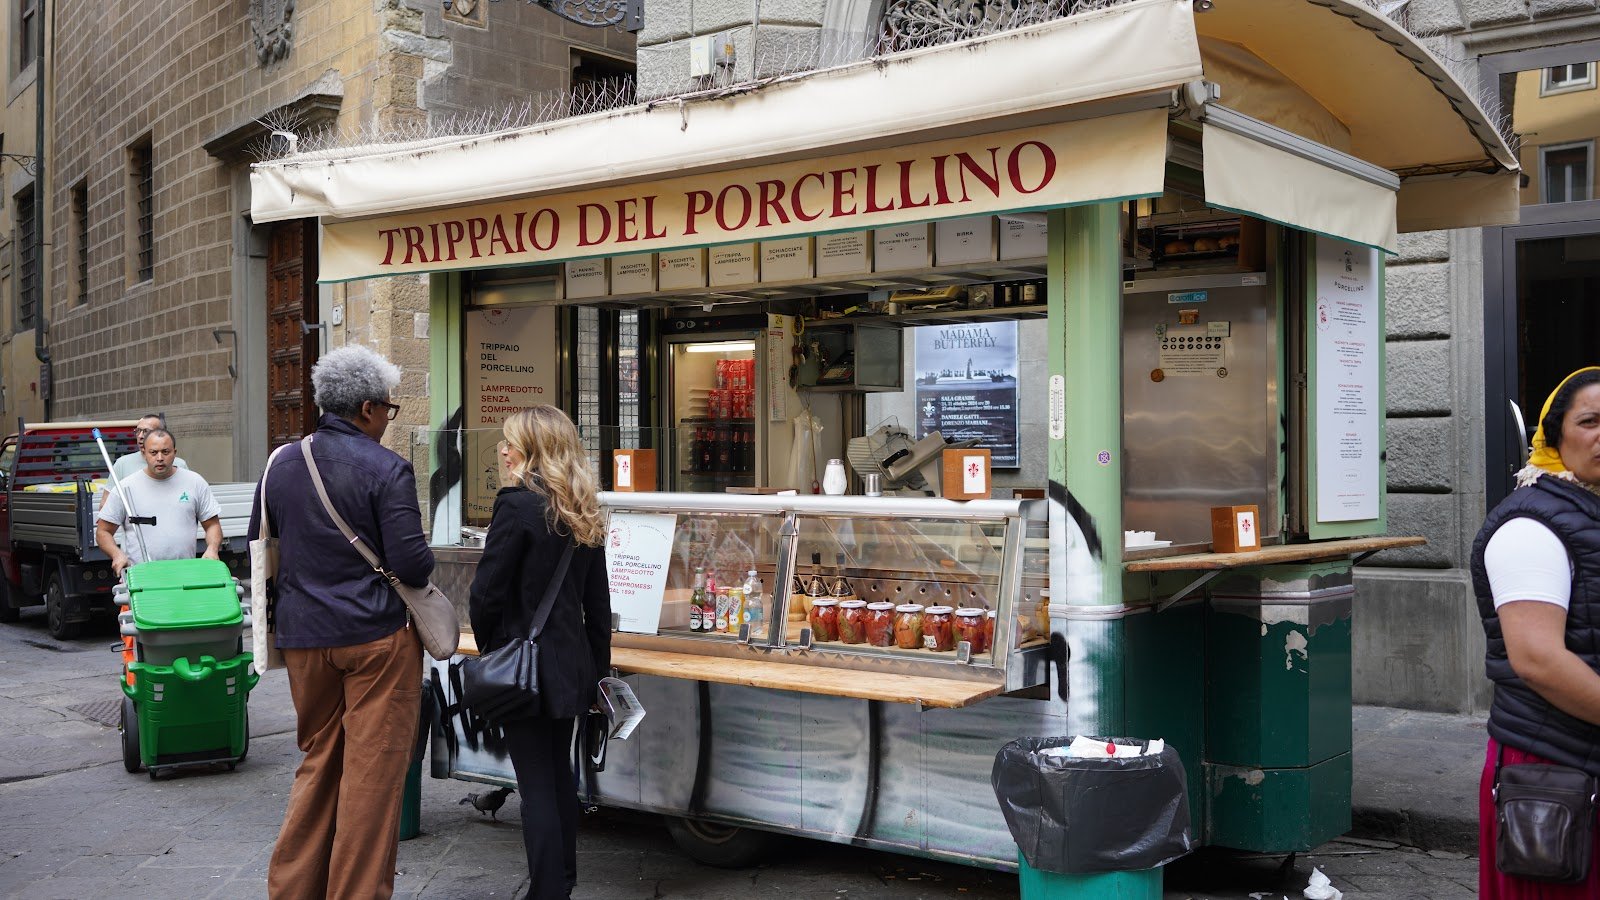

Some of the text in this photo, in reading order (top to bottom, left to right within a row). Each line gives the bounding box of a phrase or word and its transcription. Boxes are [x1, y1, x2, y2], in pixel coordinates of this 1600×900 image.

[378, 140, 1058, 267] TRIPPAIO DEL PORCELLINO
[768, 245, 803, 255] SCHIACCIATE
[668, 256, 695, 264] VASCHETTA
[714, 256, 751, 265] LAMPREDOTTO
[571, 271, 603, 279] LAMPREDOTTO
[617, 267, 650, 276] LAMPREDOTTO
[1334, 280, 1364, 293] PORCELLINO
[940, 328, 991, 340] MADAMA
[480, 342, 520, 352] TRIPPAIO
[934, 337, 998, 350] BUTTERFLY
[480, 353, 497, 361] DEL
[480, 363, 535, 374] PORCELLINO
[481, 385, 544, 394] LAMPREDOTTO
[481, 395, 510, 403] SENZA
[481, 405, 525, 414] COMPROM
[481, 416, 497, 424] DAL
[468, 503, 493, 512] PORCE
[614, 553, 640, 561] TRIPPAIO
[624, 561, 662, 570] PORCELLINO
[611, 568, 655, 576] LAMPREDOTTO
[609, 581, 653, 590] COMPROMESSI
